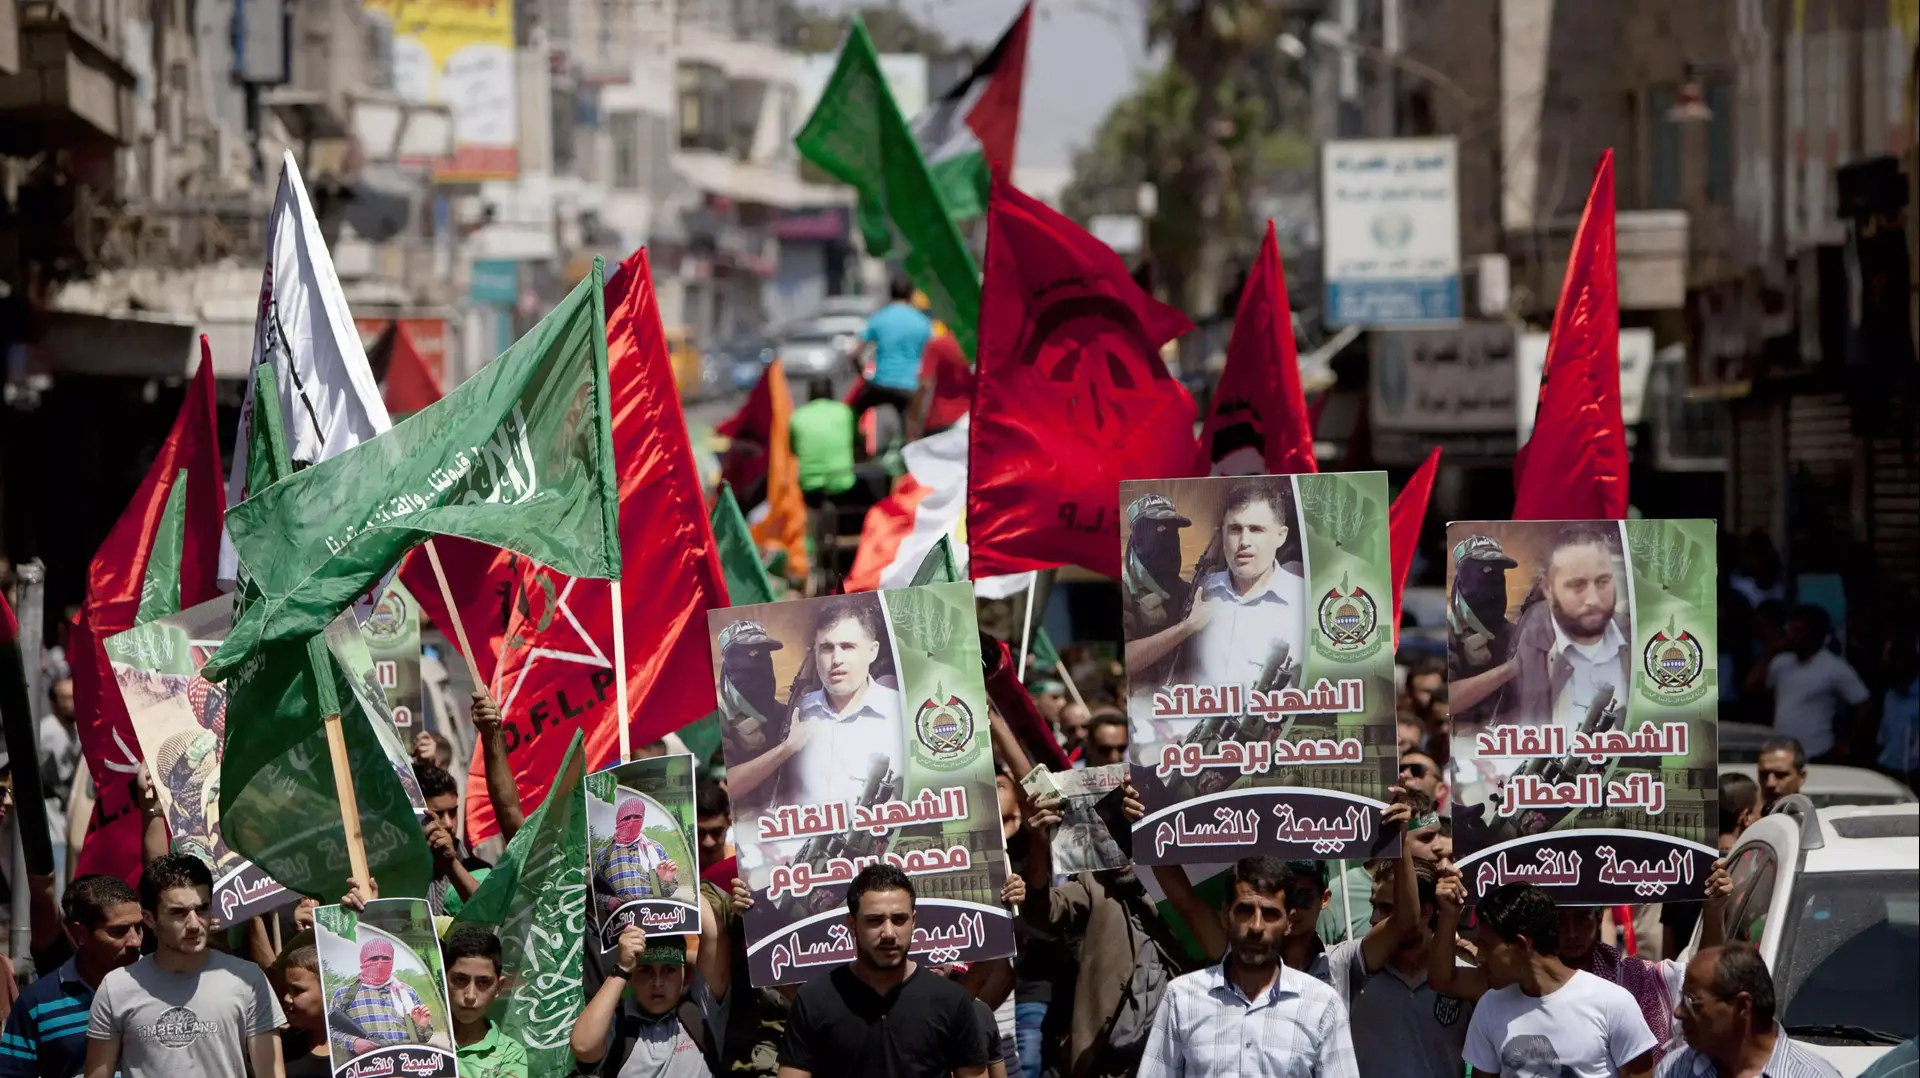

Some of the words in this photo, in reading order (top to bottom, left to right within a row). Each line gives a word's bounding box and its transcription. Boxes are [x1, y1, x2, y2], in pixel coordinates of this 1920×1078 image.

[1153, 682, 1243, 718] القائد
[1248, 678, 1364, 722] الشهيد
[1157, 739, 1270, 777] برهوم
[1276, 738, 1362, 764] محمد
[1476, 724, 1566, 757] القائد
[1573, 721, 1690, 764] الشهيد
[854, 787, 968, 836] الشهيد
[1500, 774, 1602, 817] العطار
[1607, 773, 1665, 815] رائد
[759, 801, 848, 843] القائد
[1155, 808, 1260, 857] للقسام
[1273, 804, 1371, 853] البيعة
[887, 846, 970, 876] محمد
[1477, 847, 1582, 897] للقسام
[1596, 846, 1694, 896] البيعة
[641, 906, 686, 929] البيعة
[911, 912, 985, 963] البيع
[772, 925, 856, 980] قسام
[399, 1053, 444, 1075] البيعة
